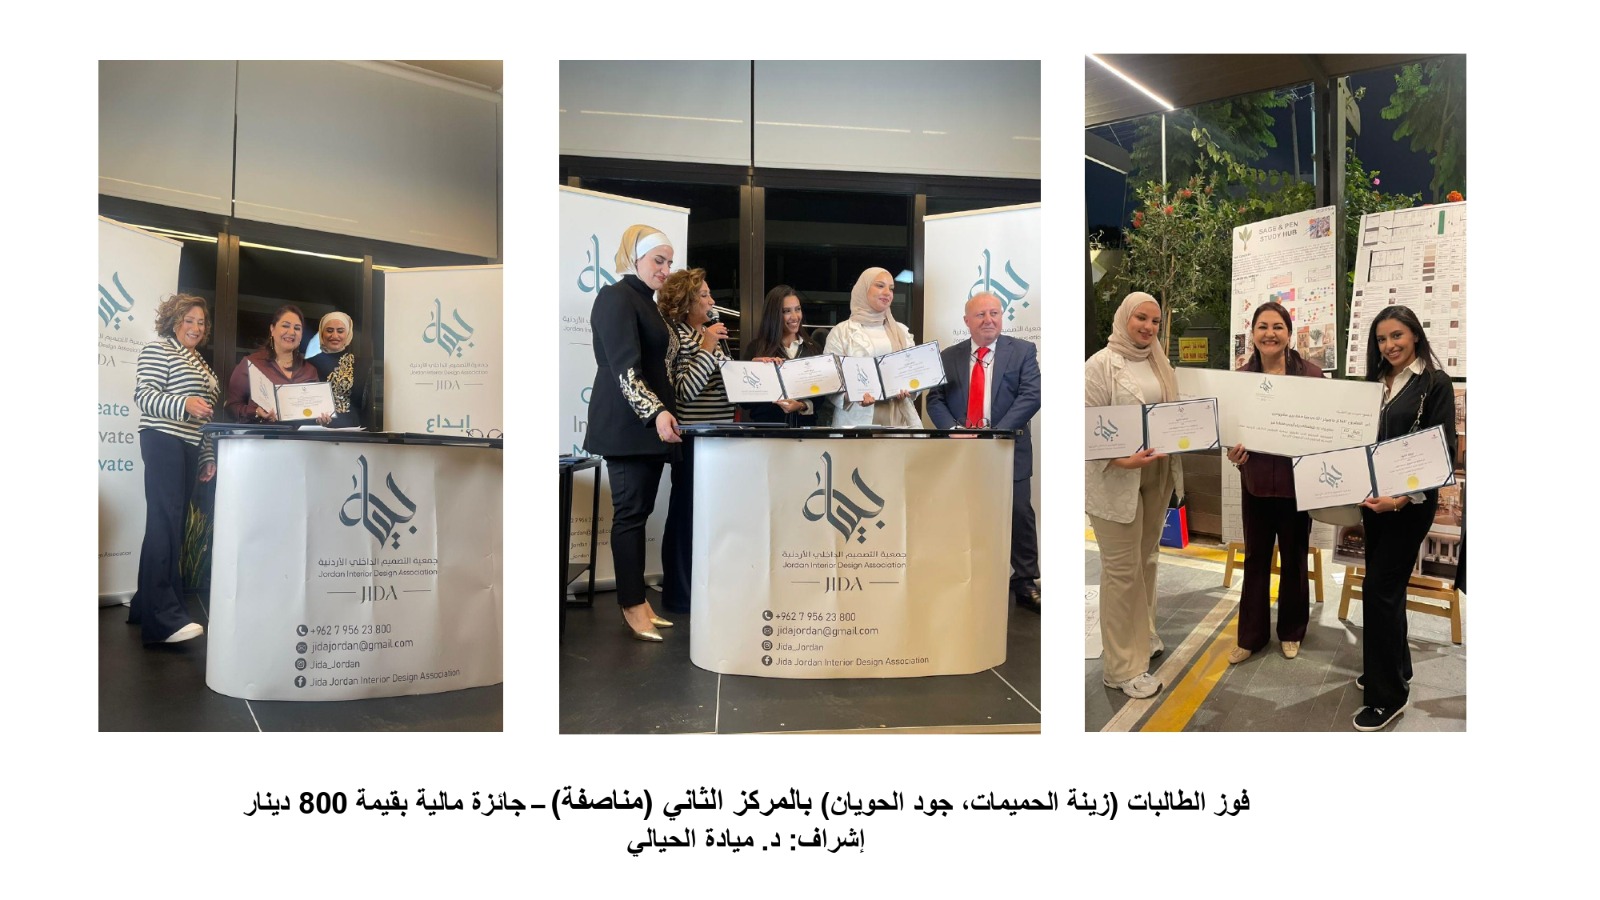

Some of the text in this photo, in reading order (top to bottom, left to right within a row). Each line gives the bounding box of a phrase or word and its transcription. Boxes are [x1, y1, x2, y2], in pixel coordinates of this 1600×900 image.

[1258, 226, 1277, 235] SAGE
[1284, 221, 1299, 230] PEN
[1259, 229, 1298, 242] STUDY HUB
[436, 380, 460, 391] JIDA
[781, 550, 907, 560] جمعية التصميم الداخلي الأردنية
[318, 557, 438, 567] جمعية التصميم الداخلي الأردنية
[782, 561, 907, 570] Jordan Interior Design Association
[373, 570, 398, 578] Design
[398, 568, 438, 576] Association
[824, 576, 863, 594] JIDA
[360, 585, 398, 604] JIDA
[775, 612, 856, 622] +962 7 956 23 800
[310, 624, 392, 636] +962 7 956 23 800
[776, 626, 879, 637] jidajordan@gmail.com
[311, 639, 414, 654] jidajordan@gmail.com
[775, 642, 824, 651] Jida_Jordan
[310, 659, 361, 670] Jida_Jordan
[775, 656, 930, 667] Jida Jordan Interior Design Association
[310, 668, 461, 687] Jida Jordan Interior Design Association
